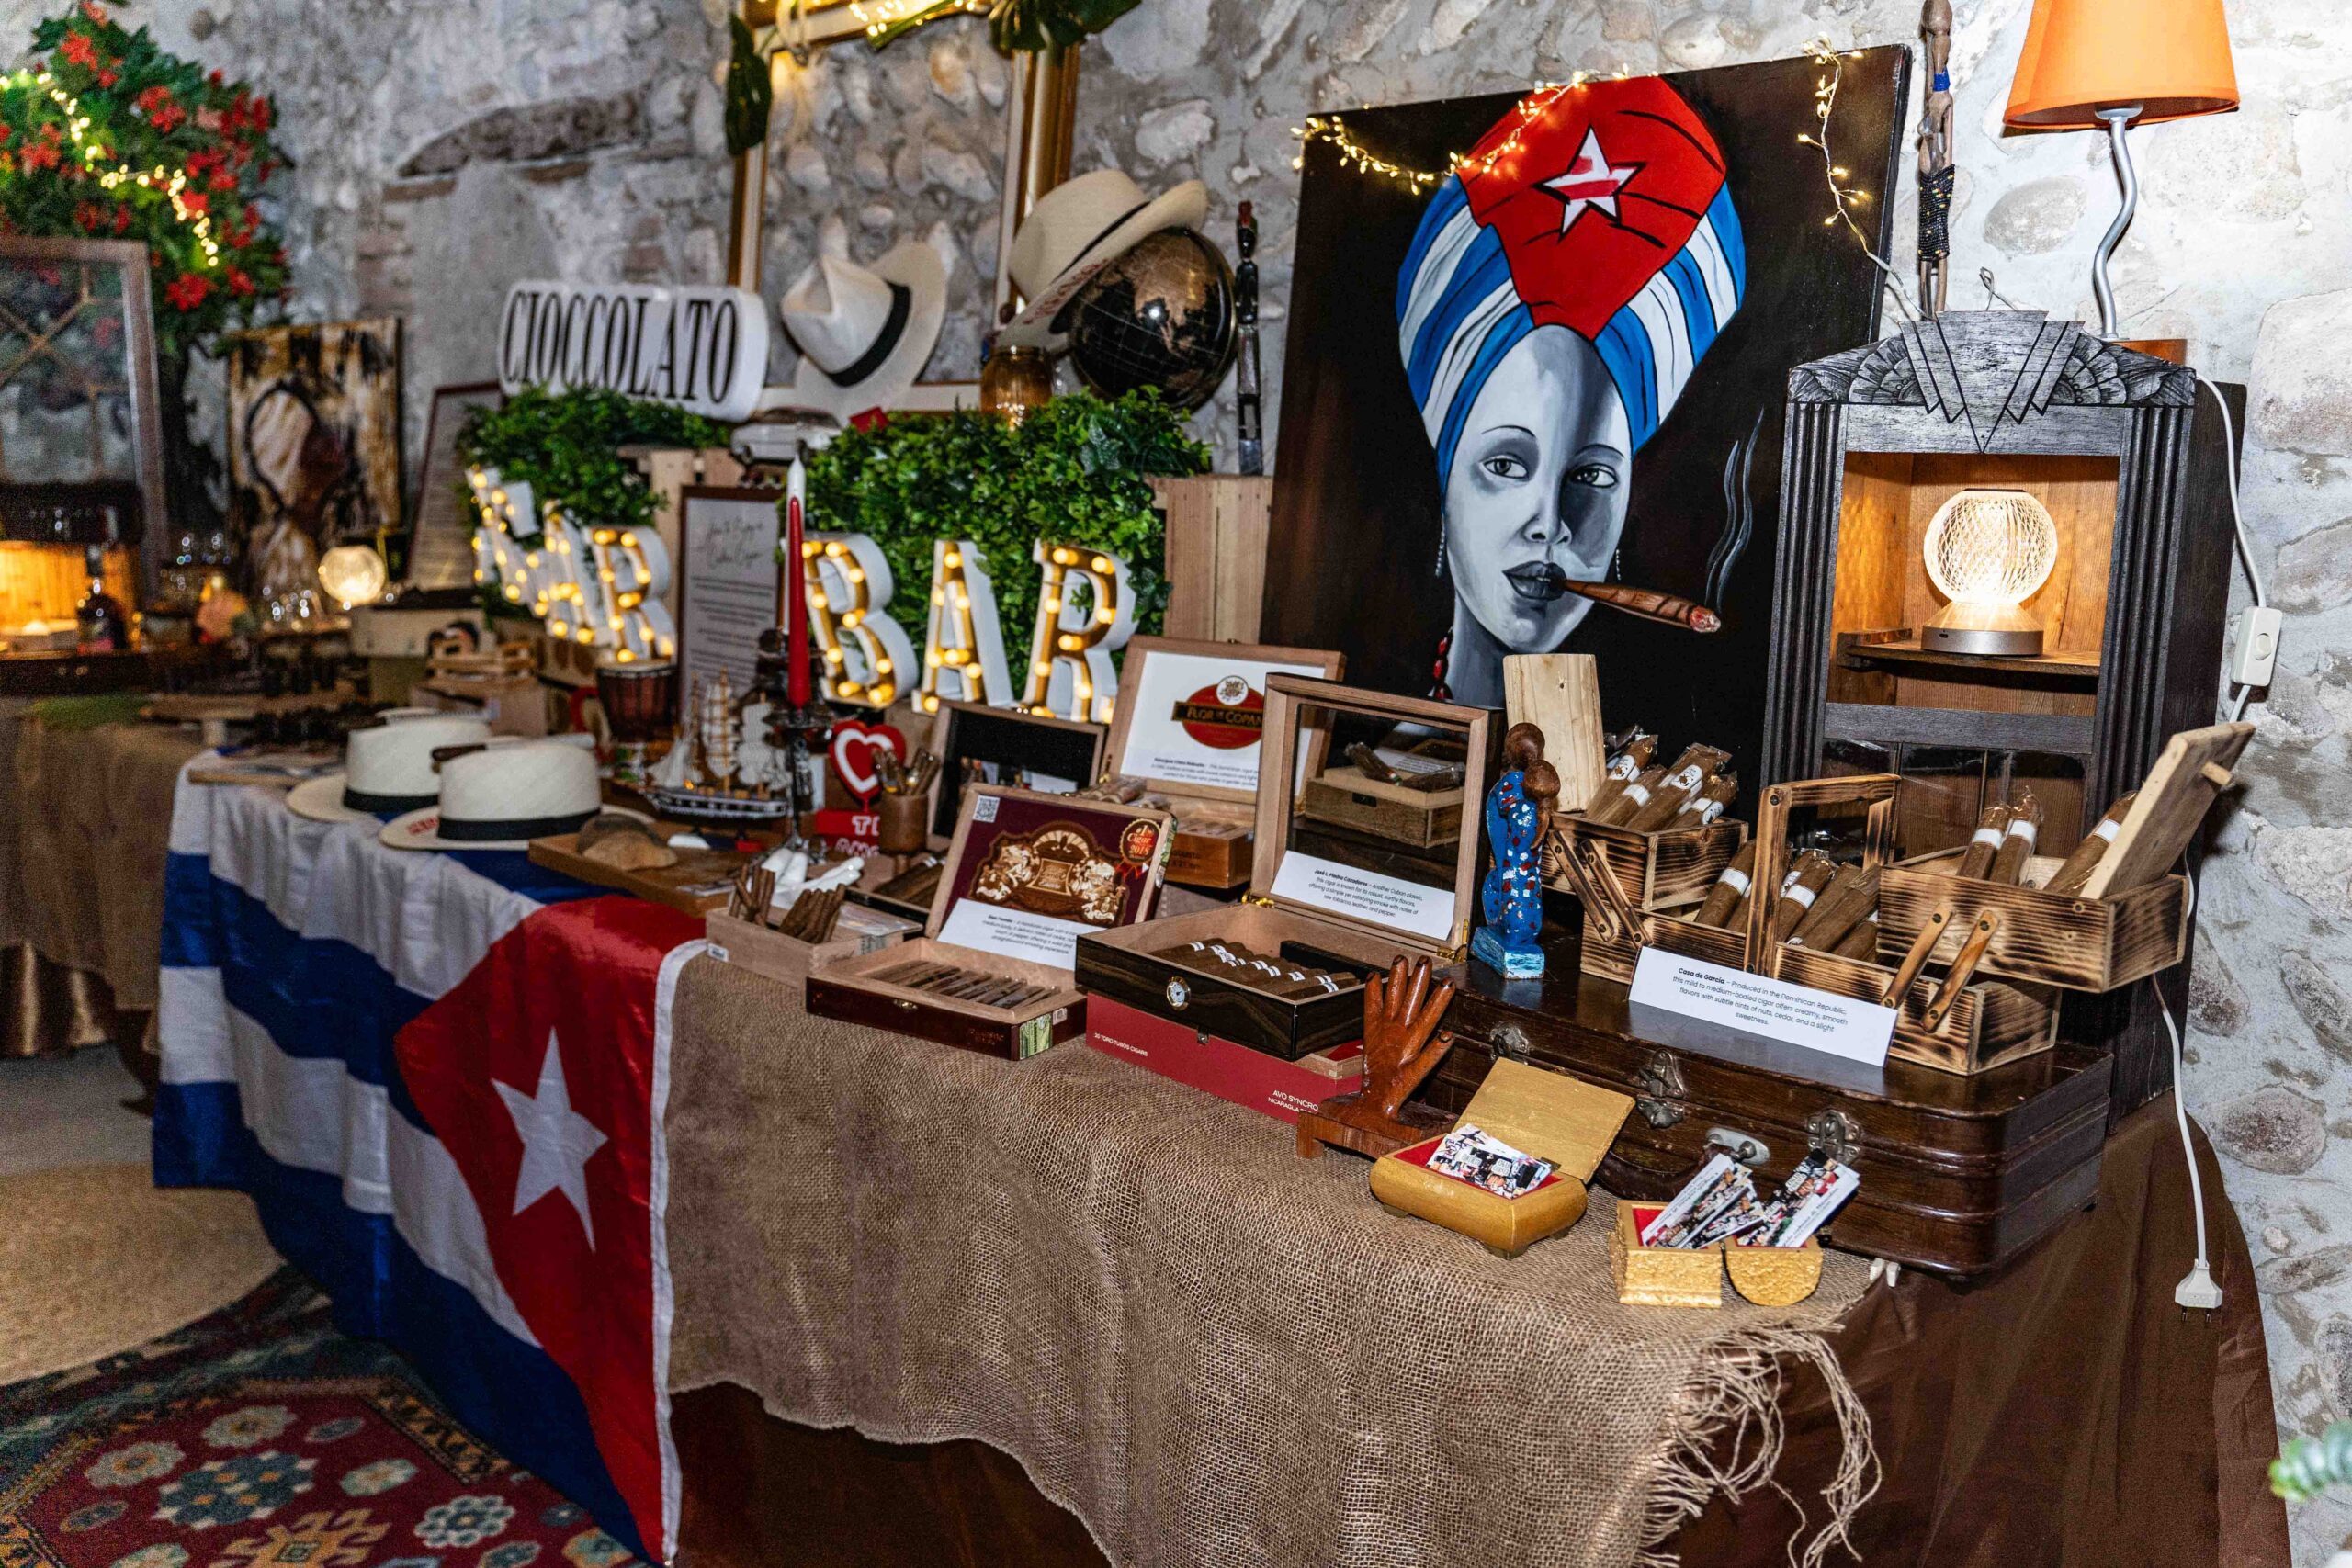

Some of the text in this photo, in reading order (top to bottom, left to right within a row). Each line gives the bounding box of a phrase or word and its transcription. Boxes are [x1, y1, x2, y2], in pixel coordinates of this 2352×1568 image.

[504, 290, 738, 404] CIOCCOLATO
[781, 531, 1140, 724] BAR
[1308, 883, 1325, 892] offering
[1352, 895, 1374, 905] satisfying
[1329, 873, 1344, 881] Piedra
[1344, 876, 1368, 886] Cazadores
[1372, 884, 1390, 892] Another
[1390, 887, 1407, 896] Cuban
[1384, 895, 1398, 903] earthy
[1678, 967, 1694, 977] Casa
[1703, 975, 1724, 985] García
[1731, 980, 1761, 993] Produced
[1769, 989, 1780, 998] the
[1781, 993, 1815, 1007] Dominican
[1672, 976, 1684, 984] this
[1684, 978, 1698, 987] mild
[1706, 985, 1757, 1002] medium-bodied
[1758, 998, 1774, 1007] cigar
[1775, 1001, 1793, 1011] offers
[1794, 1007, 1821, 1020] creamy,
[1821, 1014, 1849, 1026] smooth
[1679, 987, 1700, 998] flavors
[1701, 992, 1714, 1001] with
[1714, 997, 1734, 1006] subtle
[1735, 1001, 1750, 1010] hints
[1758, 1008, 1773, 1017] nuts,
[1774, 1011, 1794, 1022] cedar,
[1795, 1017, 1809, 1026] and
[1815, 1022, 1835, 1032] slight
[1735, 1011, 1770, 1026] sweetness.
[1101, 1034, 1114, 1044] TORO
[1130, 1045, 1148, 1057] CIGARS
[1268, 1096, 1300, 1113] NICARAGUA
[1272, 1089, 1288, 1100] AVO
[1288, 1094, 1319, 1111] SYNCRO
